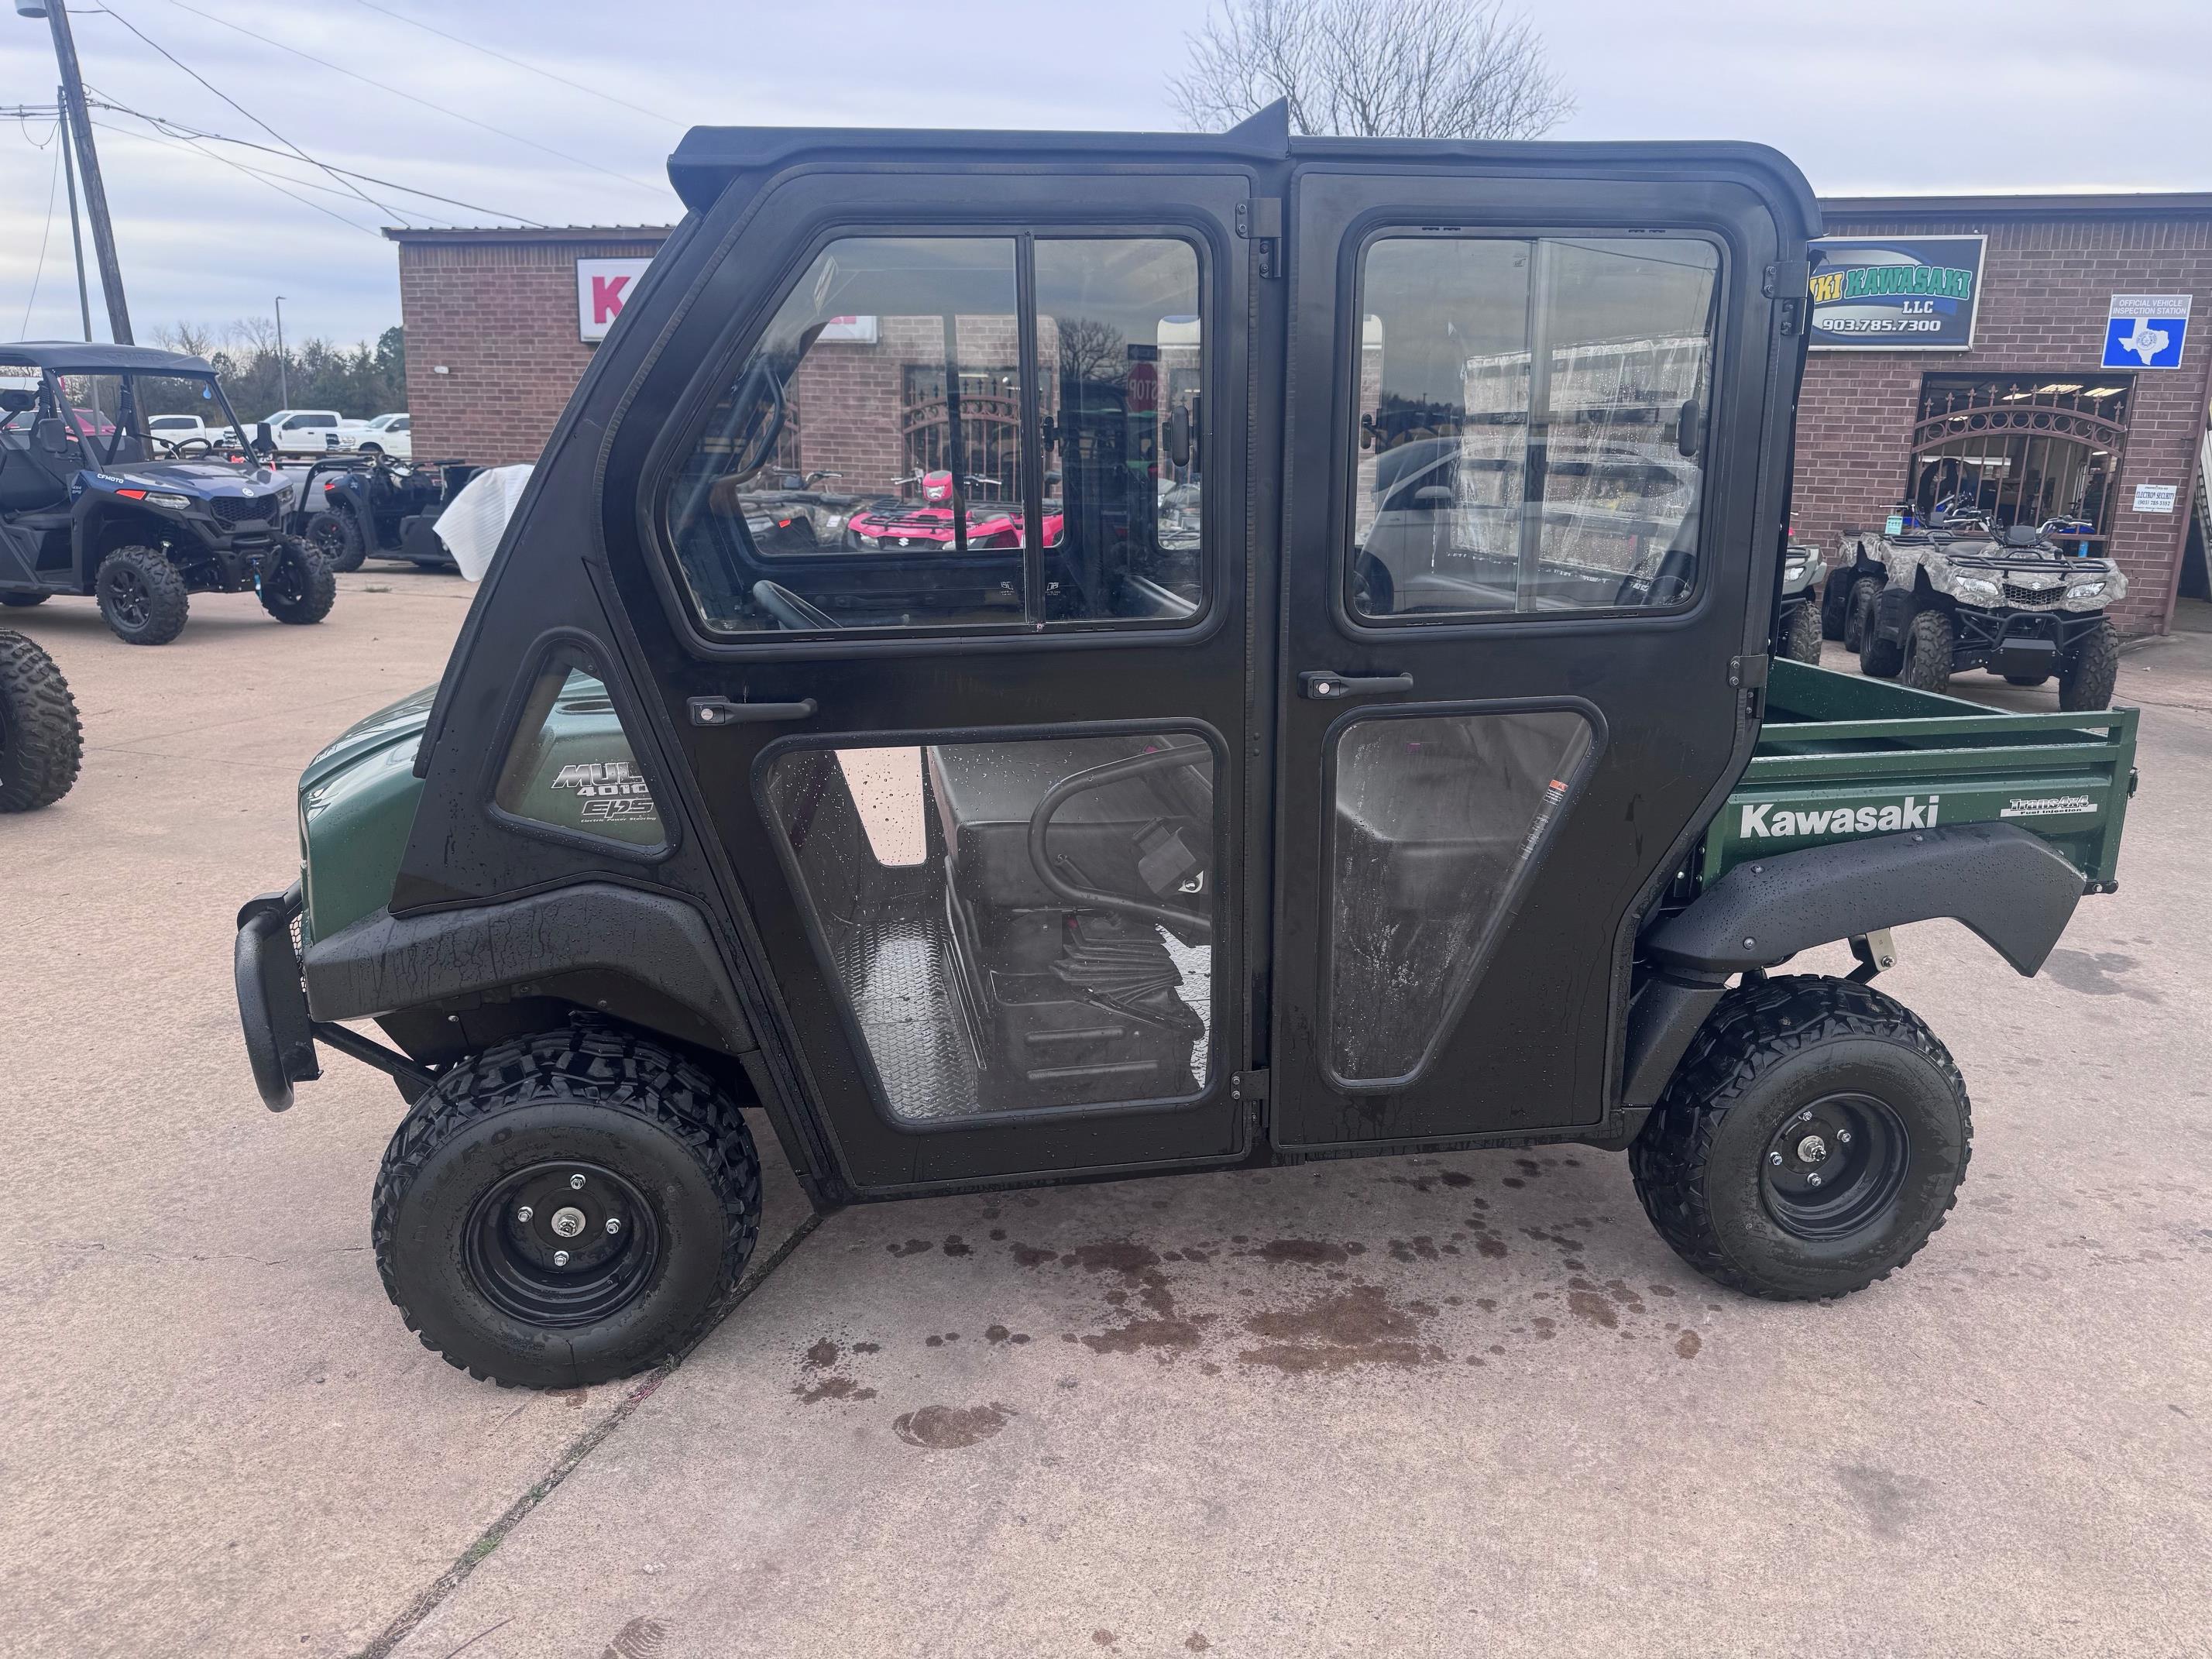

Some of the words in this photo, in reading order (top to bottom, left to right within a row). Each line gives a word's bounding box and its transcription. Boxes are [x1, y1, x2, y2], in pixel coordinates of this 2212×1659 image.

[1845, 266, 1973, 300] KAWASAKI
[1901, 301, 1934, 314] LLC
[1822, 318, 1942, 332] 903.785.7300
[97, 473, 124, 484] CFMOTO
[577, 783, 650, 797] 4010
[581, 799, 654, 819] EPS
[2009, 795, 2090, 811] Trans4x4
[1740, 795, 1940, 839] Kawasaki
